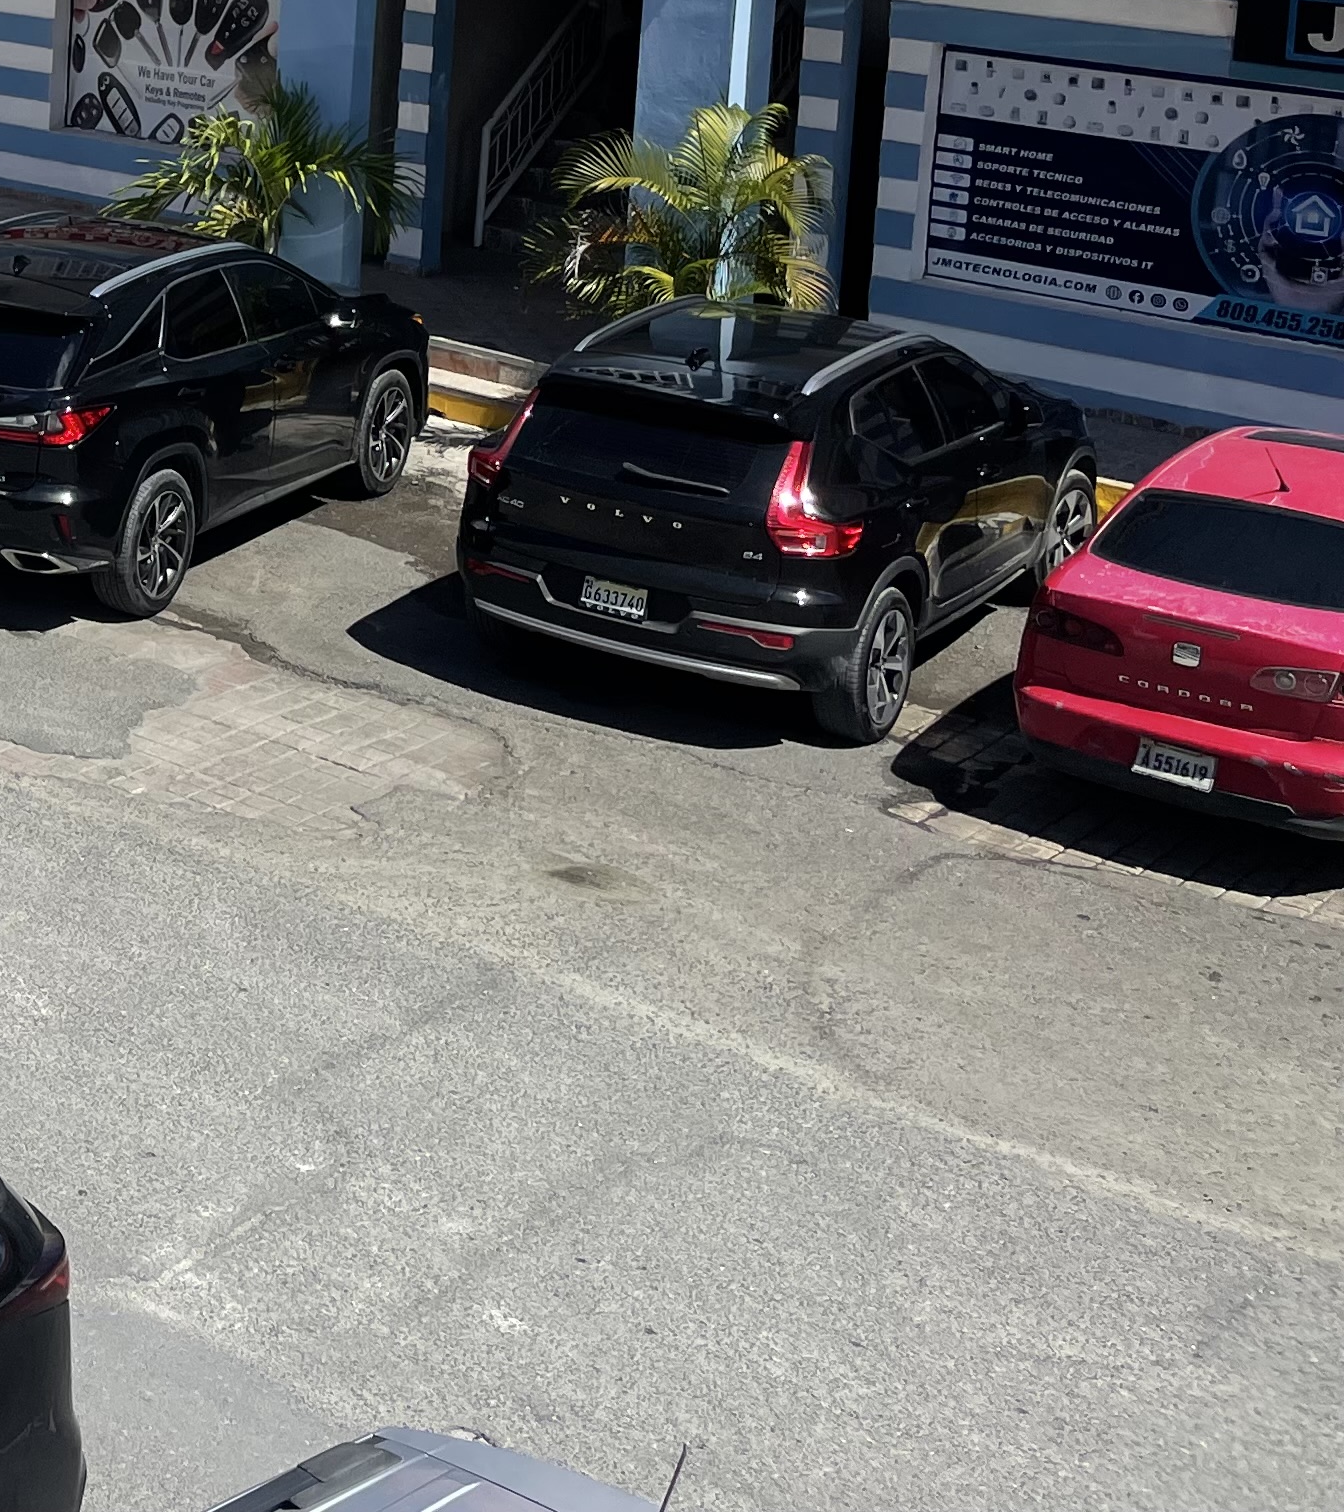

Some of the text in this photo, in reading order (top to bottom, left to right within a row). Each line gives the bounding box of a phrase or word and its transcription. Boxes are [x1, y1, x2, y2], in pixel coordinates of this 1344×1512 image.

[138, 65, 215, 88] We Have Your Car
[144, 83, 206, 103] Keys & Remotes
[978, 143, 1054, 162] SMART HOME
[977, 160, 1084, 185] SOPORTE TECNICO
[975, 178, 1161, 215] REDES Y TELECOMUNICACIONES
[972, 214, 1115, 245] CAMARAS DE SEGURIDAD
[973, 195, 1181, 237] CONTROLES DE ACCESO Y ALARMAS
[969, 231, 1154, 270] ACCESORIOS Y DISPOSITIVOS IT
[559, 495, 683, 529] VOLVO
[583, 584, 645, 612] G633740
[1118, 674, 1254, 712] CORDOBA
